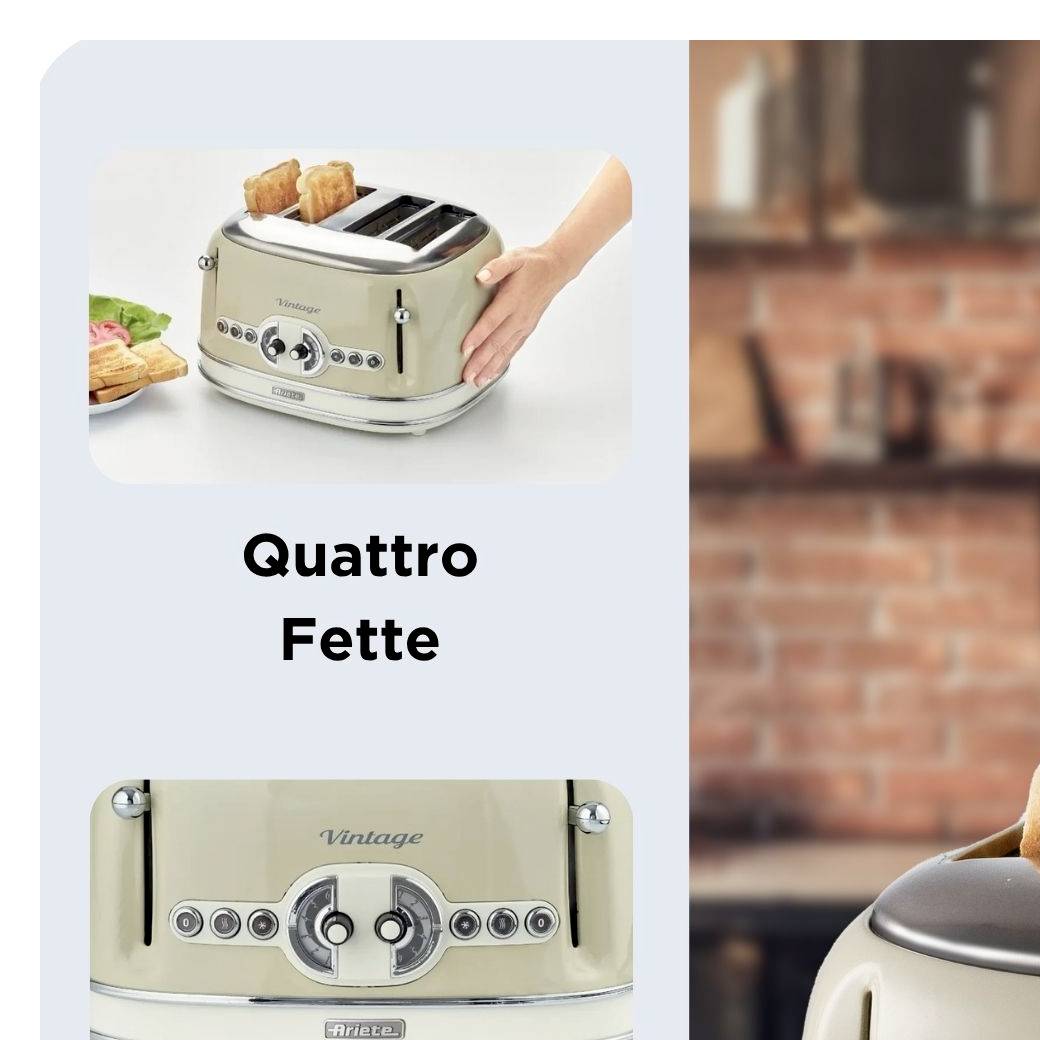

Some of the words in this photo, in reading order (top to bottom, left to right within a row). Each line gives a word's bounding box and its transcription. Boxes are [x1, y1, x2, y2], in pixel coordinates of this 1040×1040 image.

[276, 298, 321, 314] Vintage
[319, 829, 424, 850] Vintage
[328, 1023, 400, 1038] Ariete
